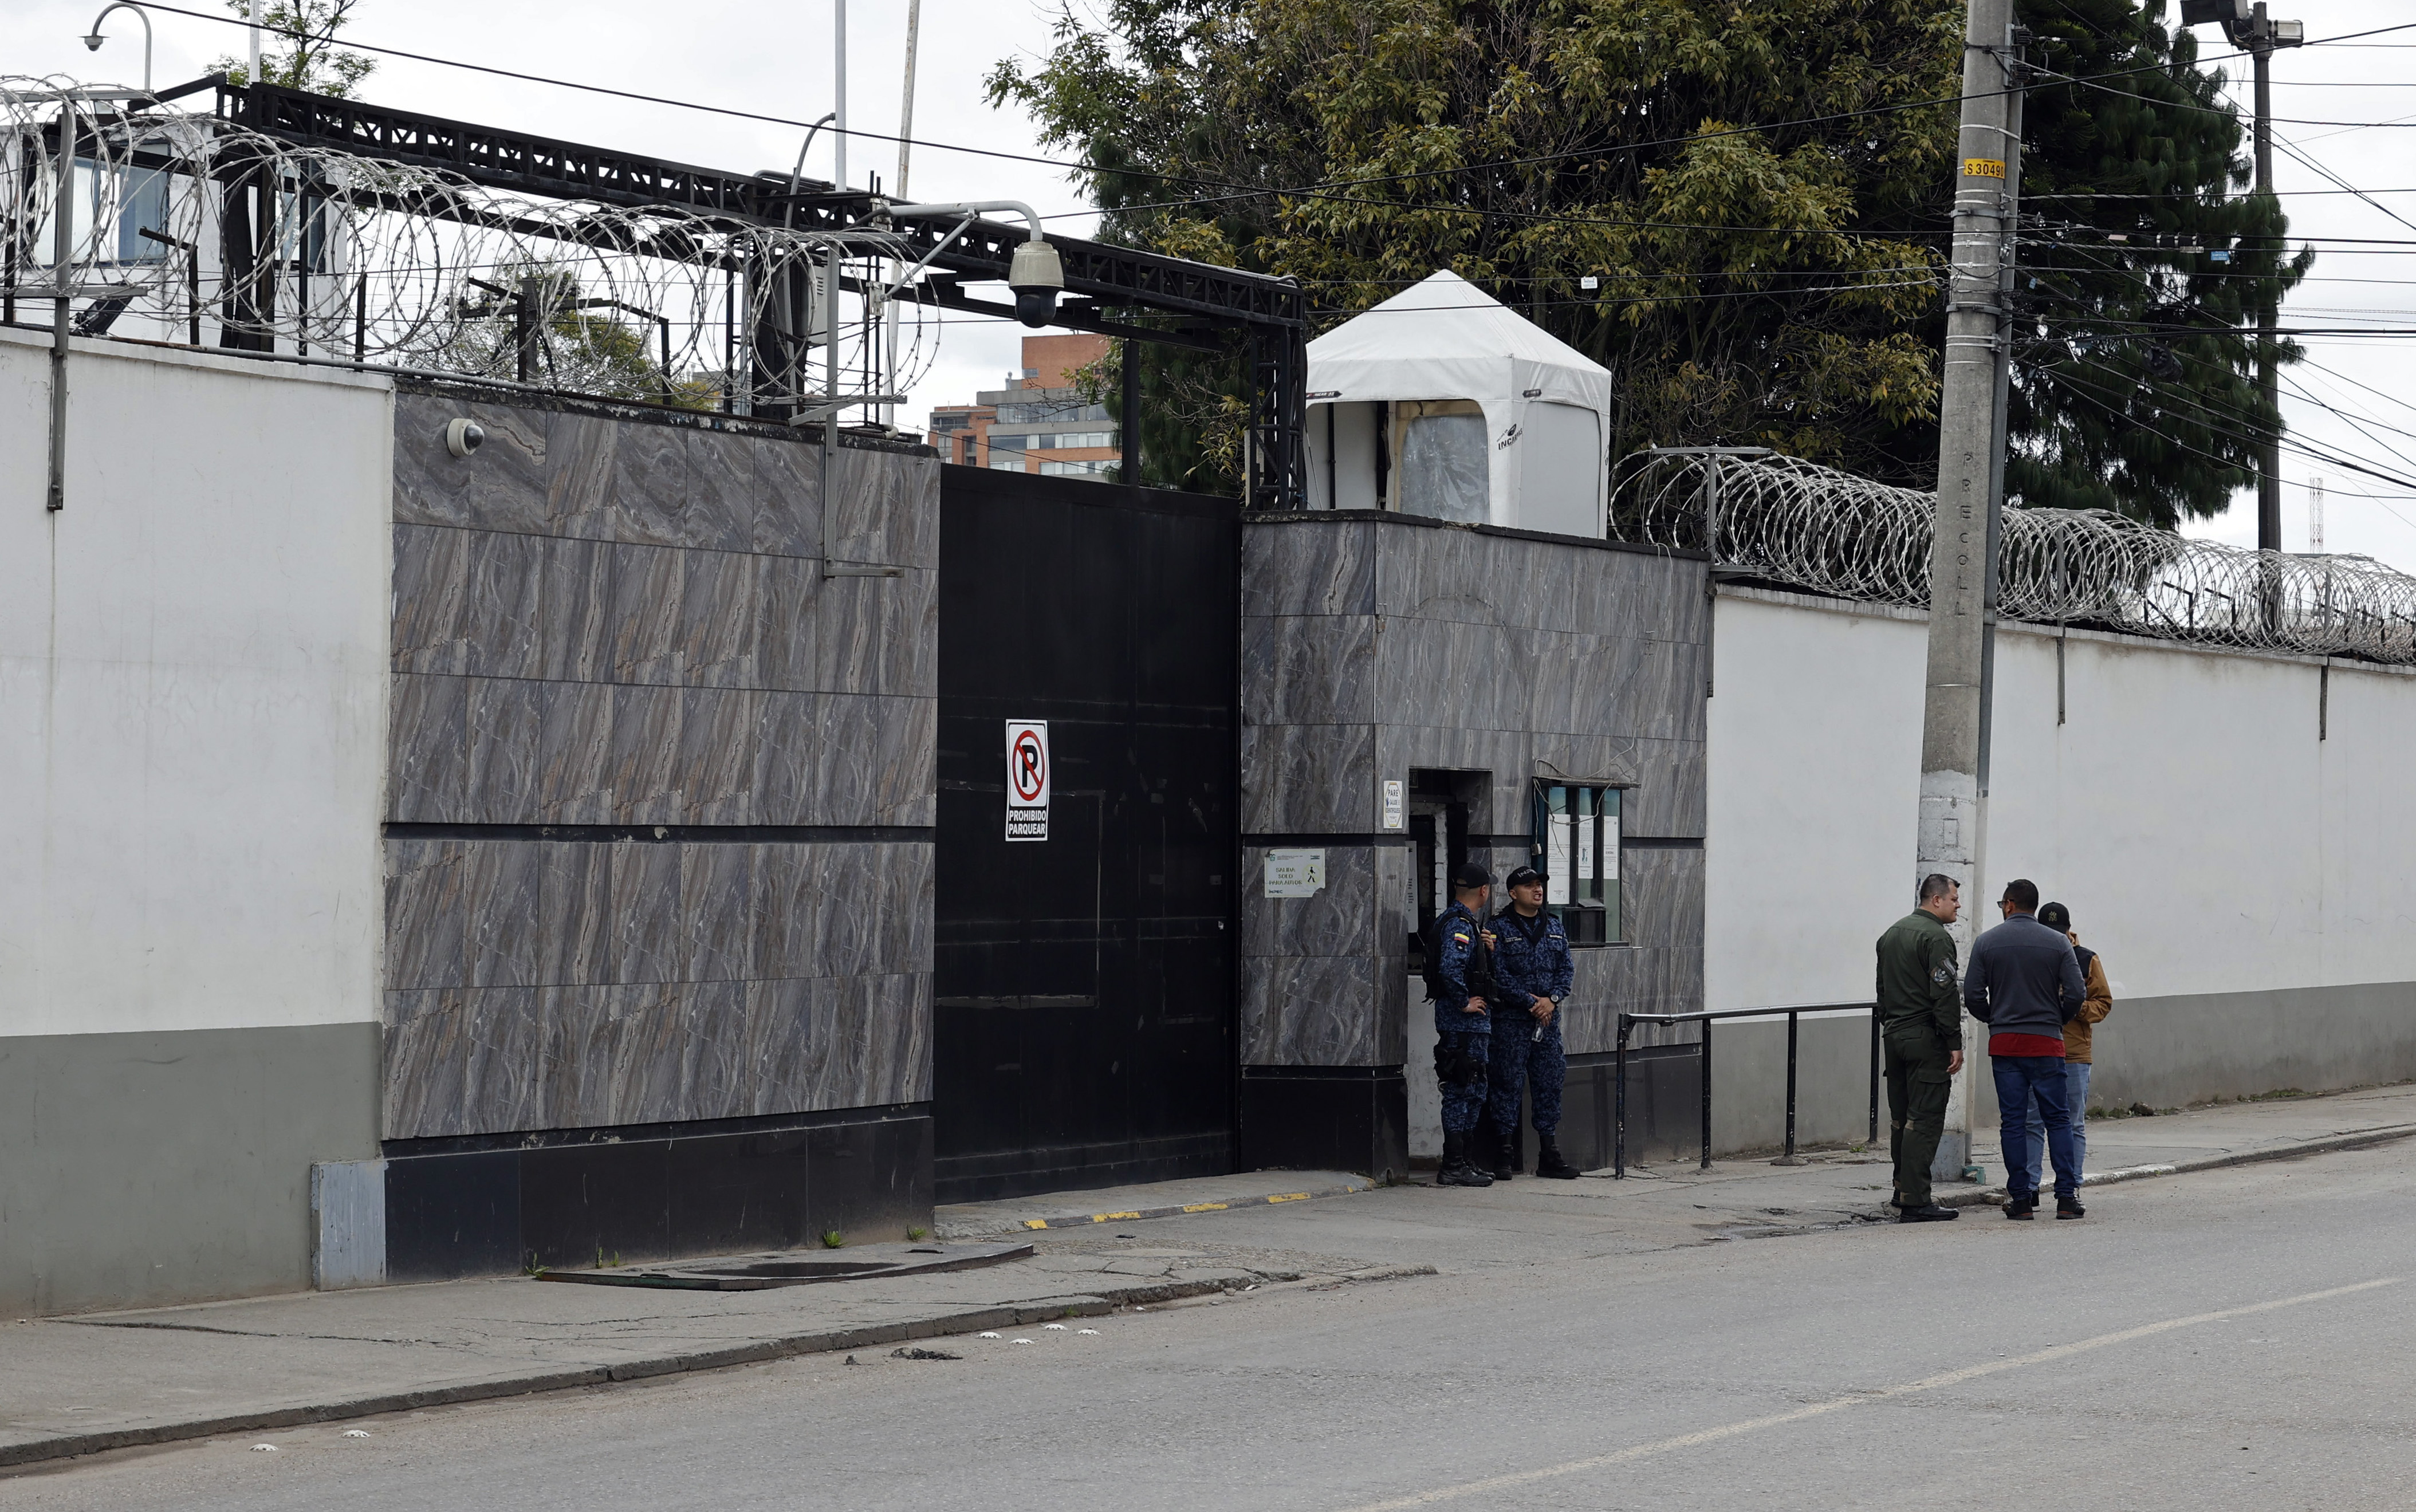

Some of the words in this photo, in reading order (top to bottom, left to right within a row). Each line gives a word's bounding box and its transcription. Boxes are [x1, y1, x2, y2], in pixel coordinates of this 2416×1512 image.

[1968, 164, 1973, 174] S
[1976, 164, 2004, 177] 30490
[1009, 810, 1046, 821] PROHIBIDO
[1008, 823, 1046, 835] PARQUEAR
